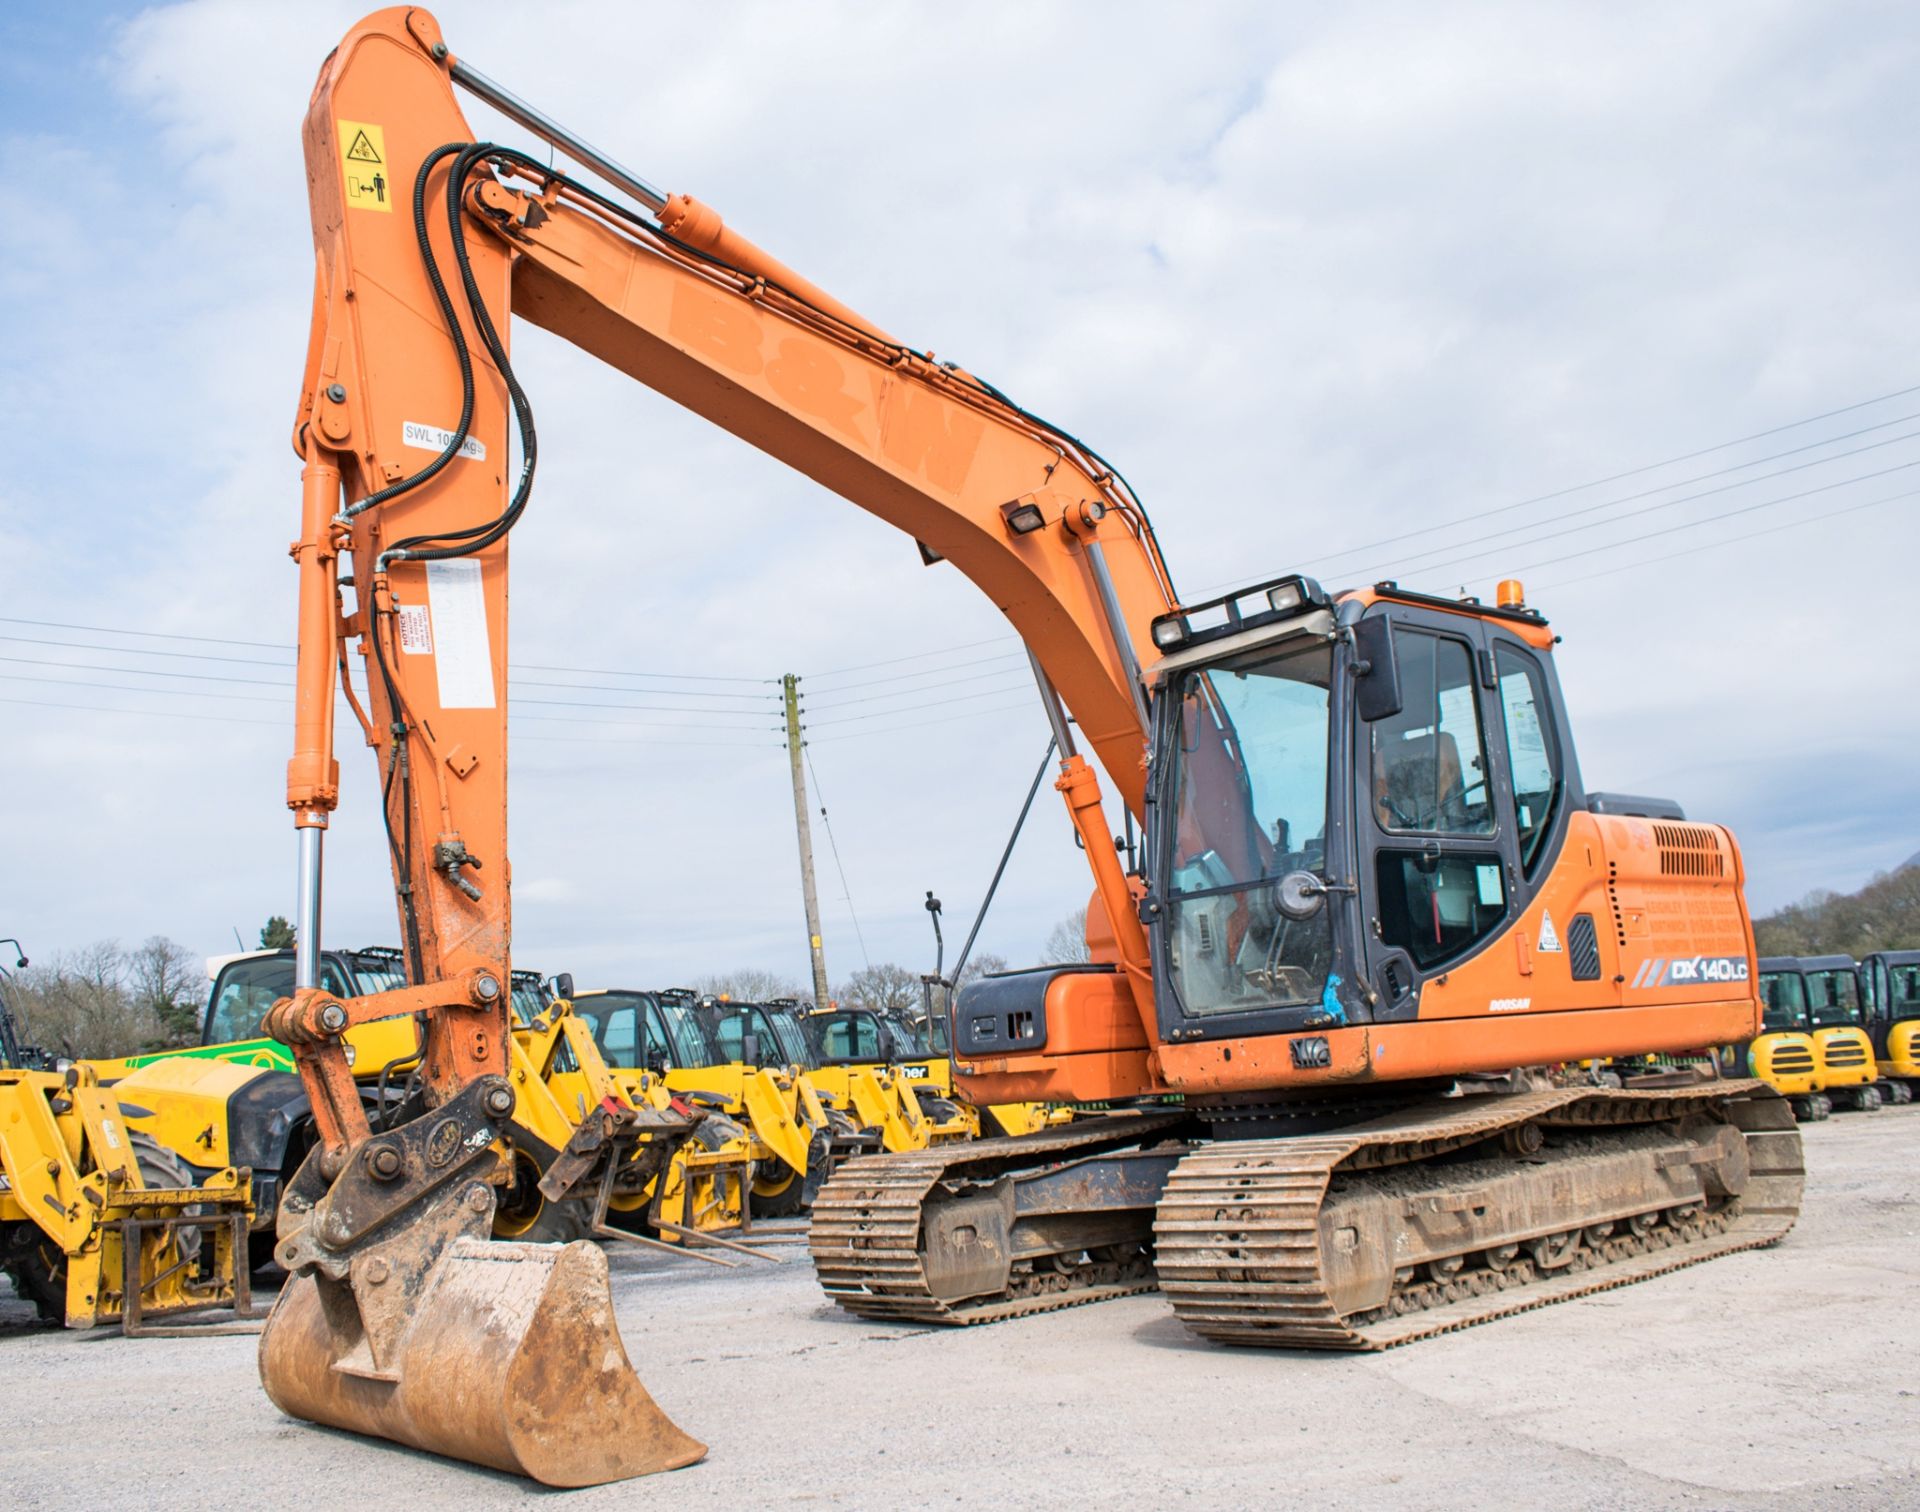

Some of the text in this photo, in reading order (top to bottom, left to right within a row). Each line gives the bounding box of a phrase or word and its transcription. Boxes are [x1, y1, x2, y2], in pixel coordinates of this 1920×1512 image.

[406, 425, 432, 442] SWL
[400, 613, 409, 646] NOTICE
[1489, 998, 1531, 1011] DOOSAN
